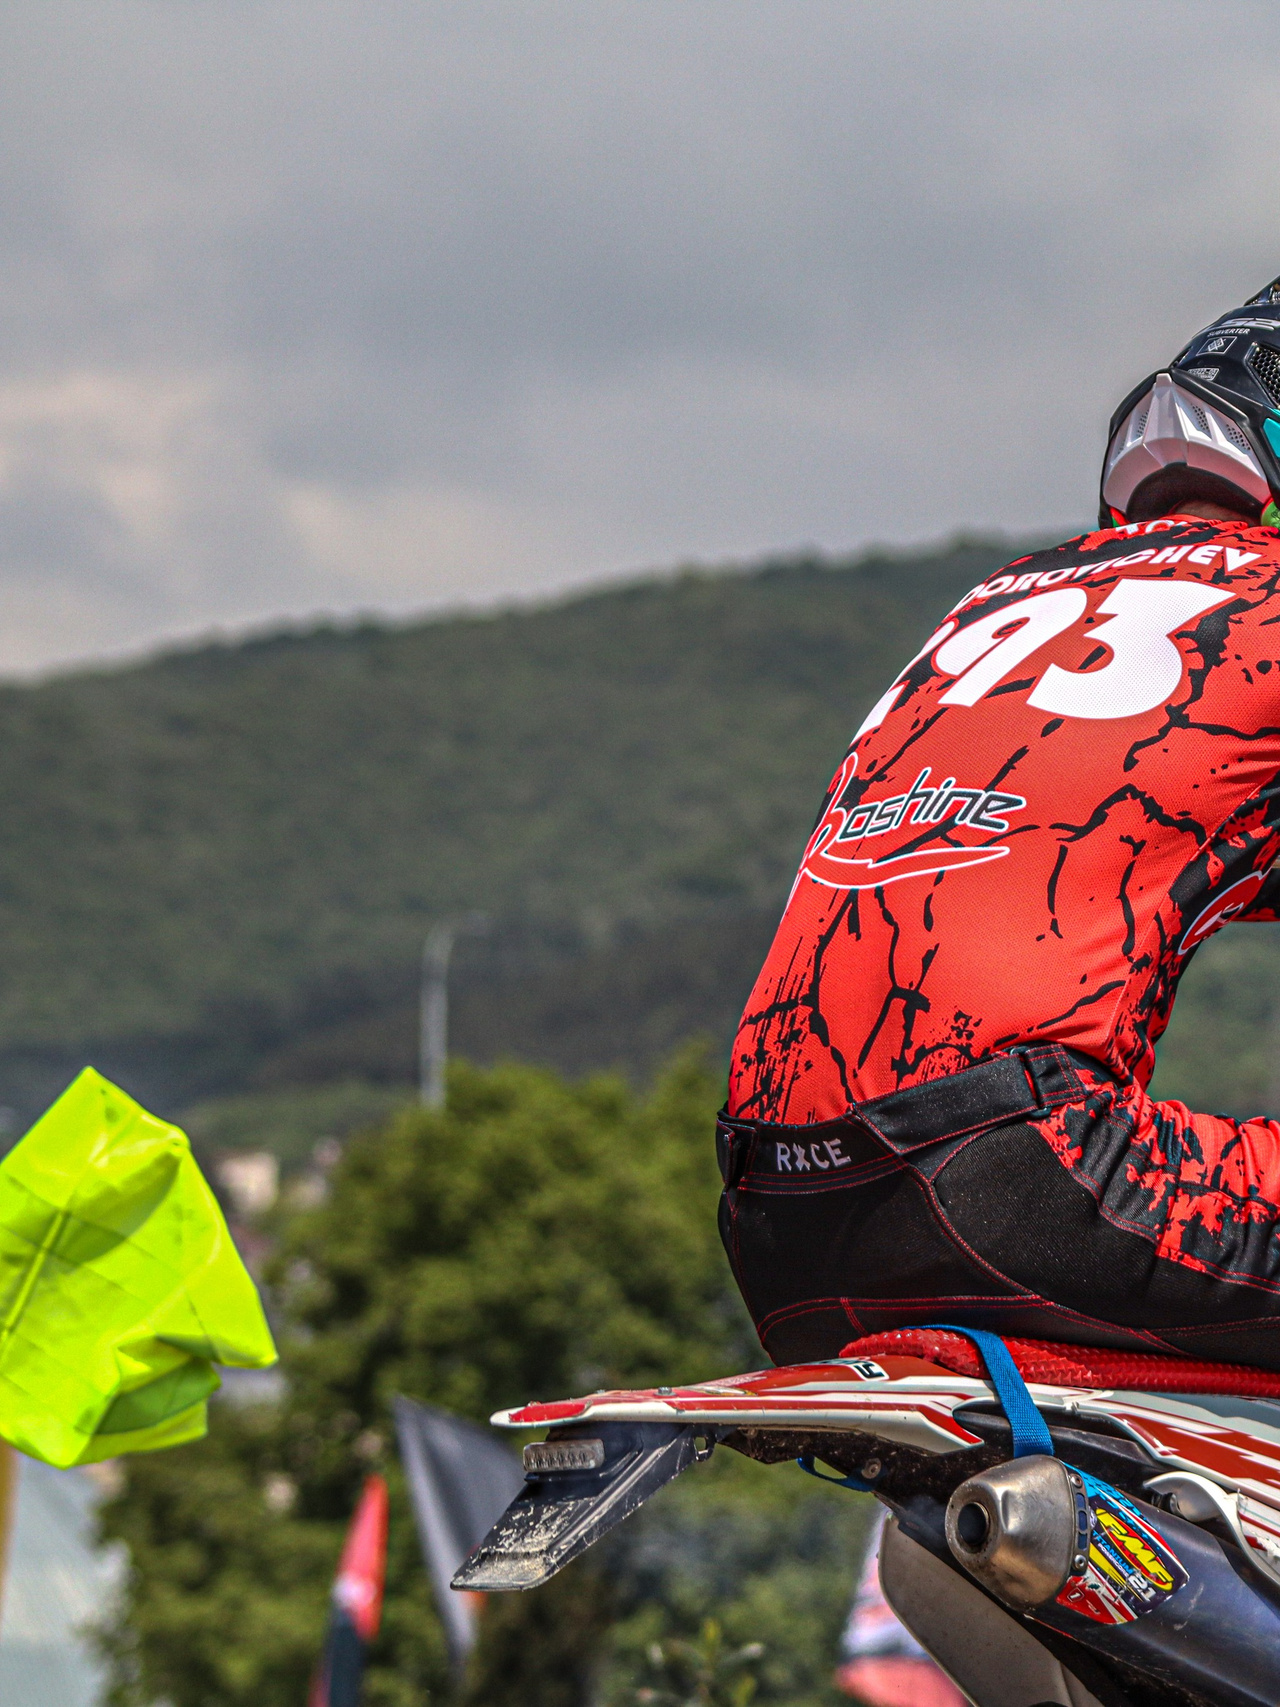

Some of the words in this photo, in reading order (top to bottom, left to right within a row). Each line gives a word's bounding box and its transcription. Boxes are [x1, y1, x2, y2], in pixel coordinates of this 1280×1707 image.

[1207, 327, 1251, 337] SUBVERTER
[1092, 1529, 1135, 1575] TITANIUM
[1096, 1510, 1174, 1583] FMF
[1097, 1542, 1130, 1580] POWERCORE
